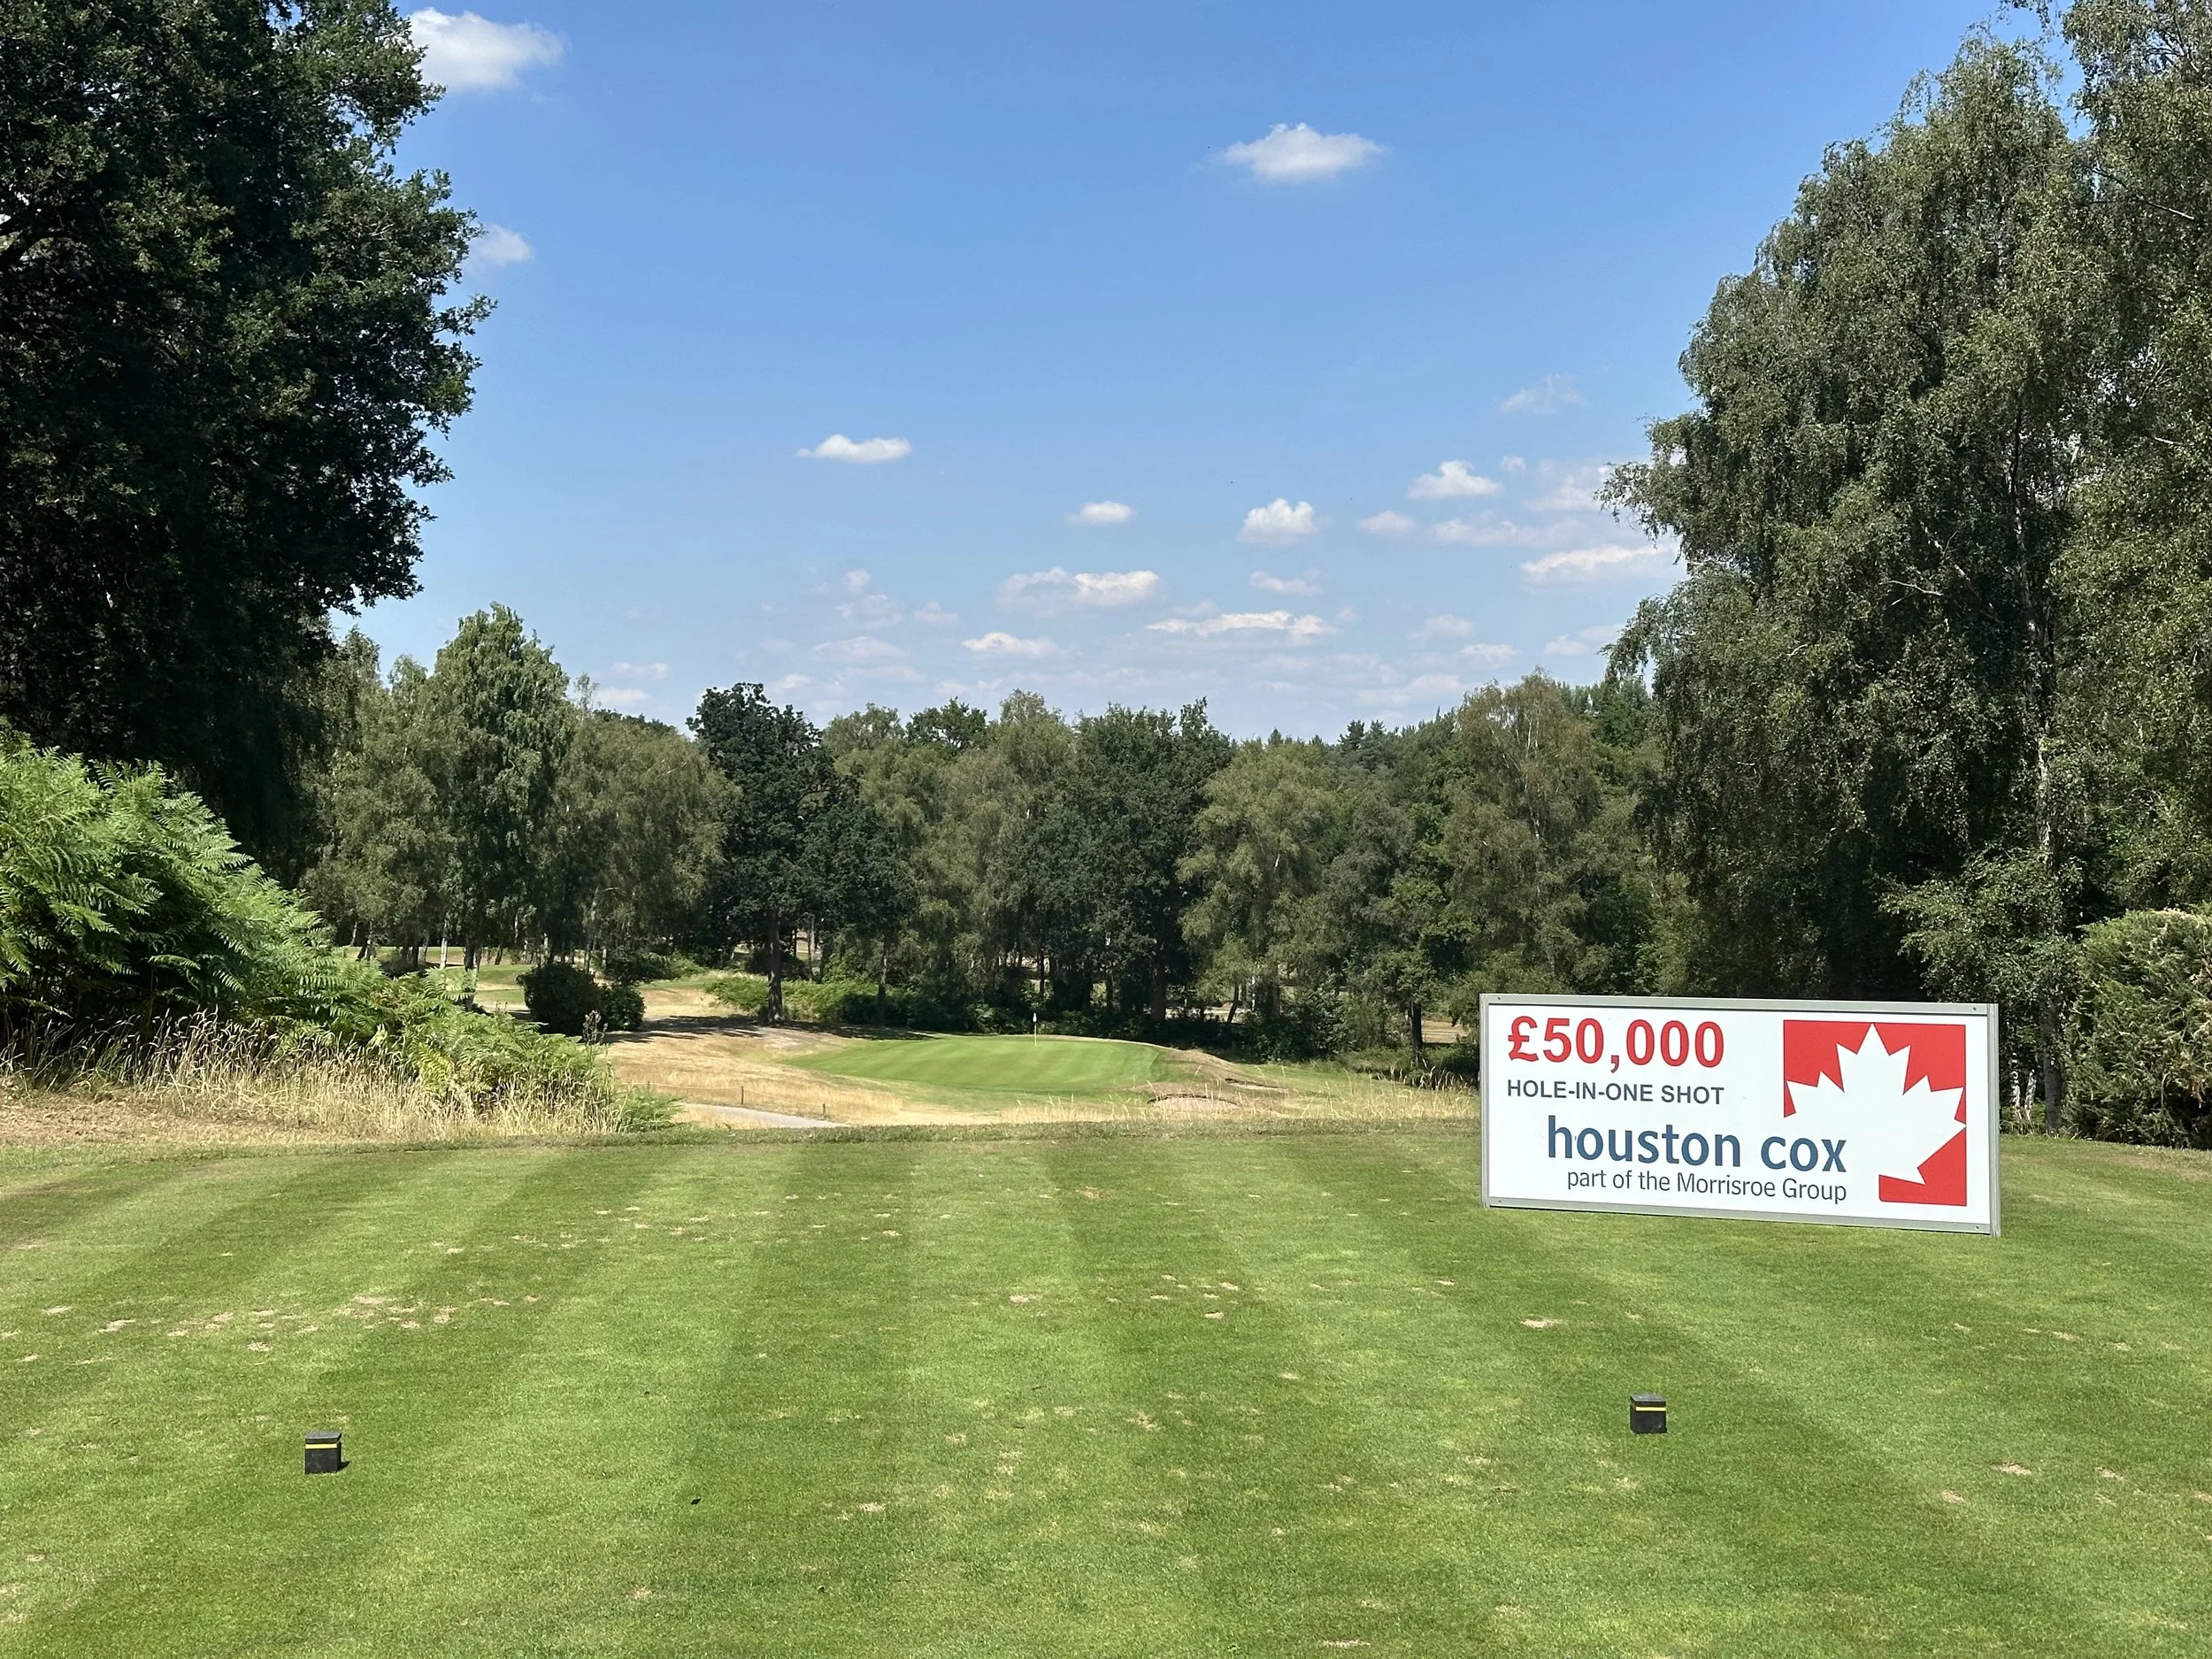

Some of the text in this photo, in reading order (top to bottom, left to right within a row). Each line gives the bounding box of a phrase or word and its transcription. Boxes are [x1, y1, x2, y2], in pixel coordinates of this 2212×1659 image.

[1507, 1016, 1724, 1072] £50,000
[1508, 1079, 1724, 1105] HOLE-IN-ONE SHOT
[1548, 1115, 1847, 1172] houston cox
[1567, 1170, 1847, 1205] part of the Morrisroe Group
